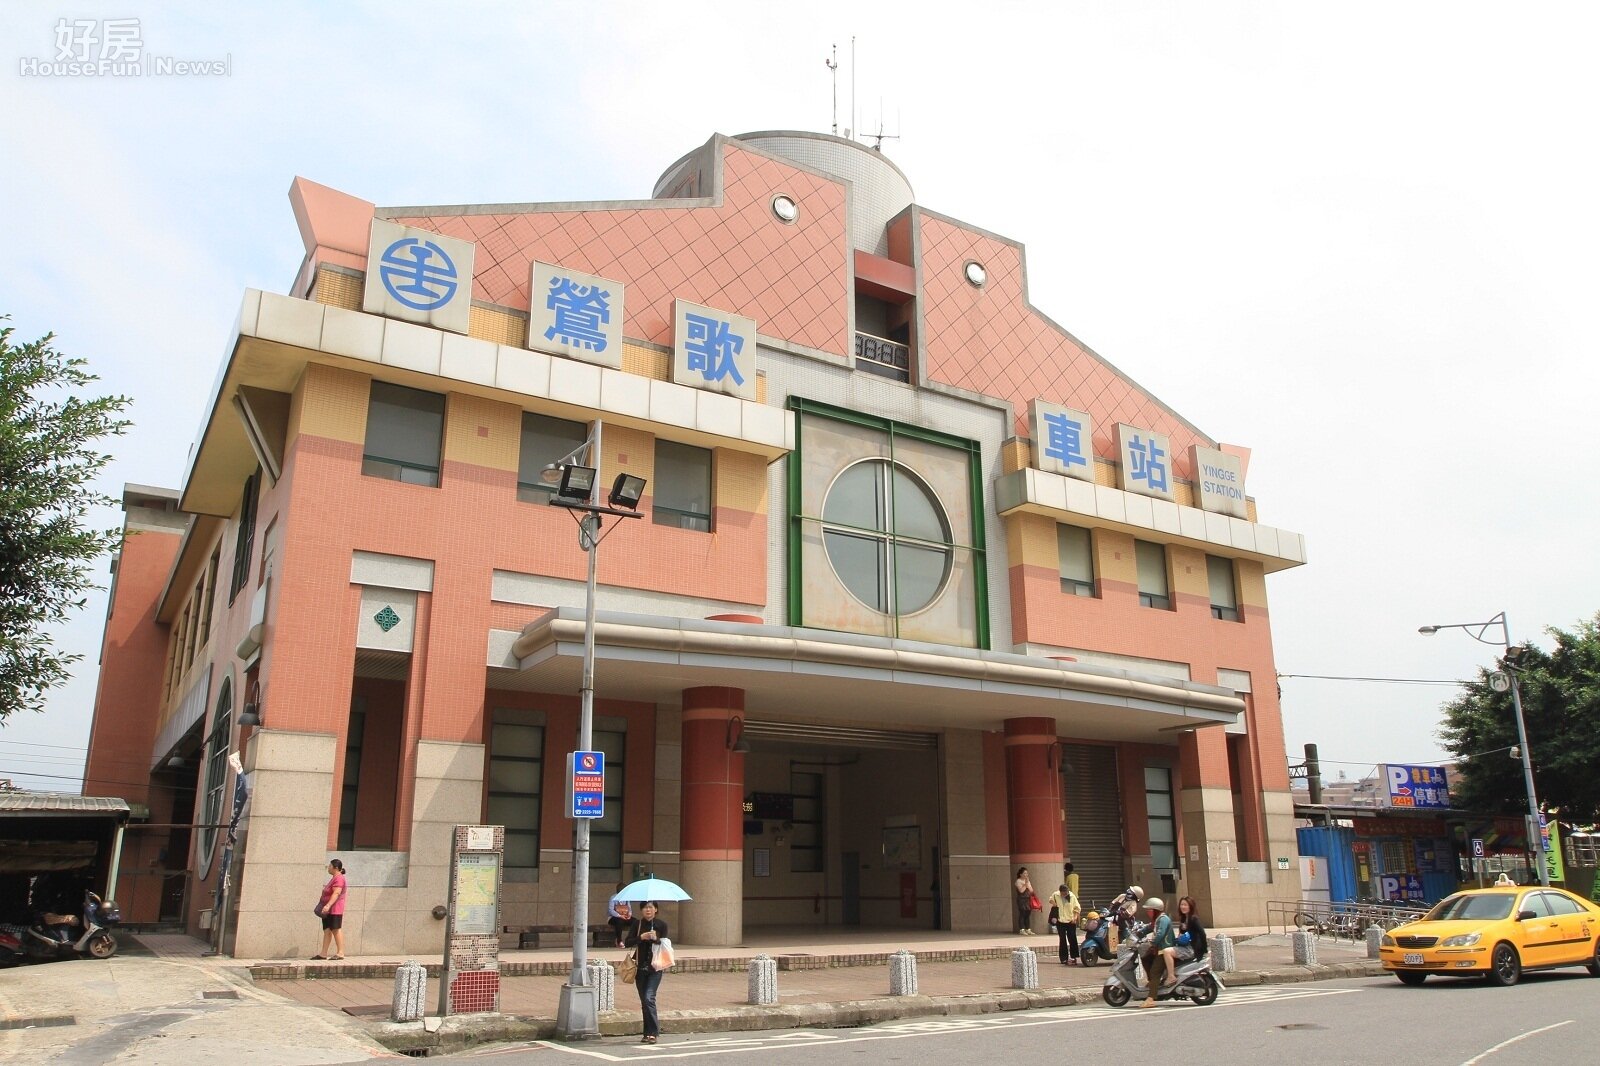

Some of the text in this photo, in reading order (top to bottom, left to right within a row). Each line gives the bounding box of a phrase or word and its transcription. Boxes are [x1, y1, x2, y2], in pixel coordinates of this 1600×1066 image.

[1203, 463, 1236, 482] YINGGE
[1204, 481, 1242, 500] STATION
[1387, 766, 1408, 793] P
